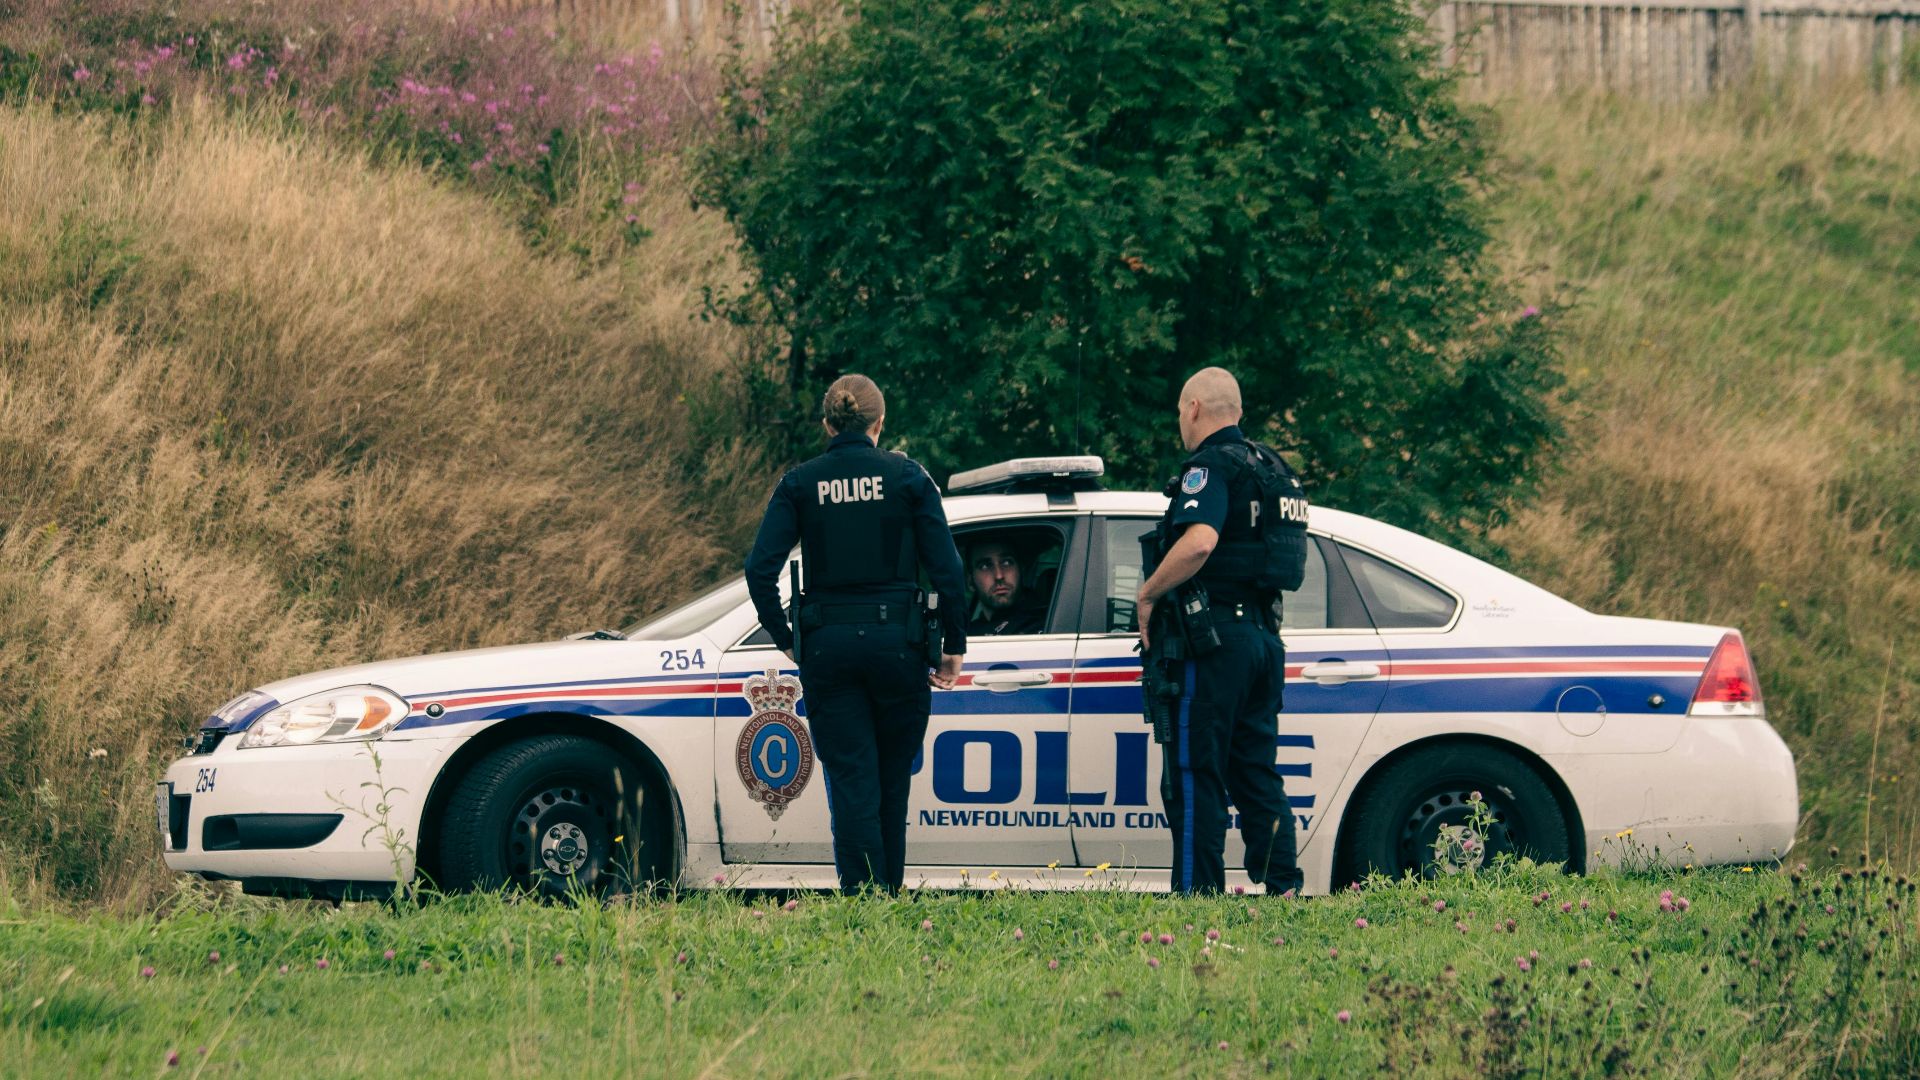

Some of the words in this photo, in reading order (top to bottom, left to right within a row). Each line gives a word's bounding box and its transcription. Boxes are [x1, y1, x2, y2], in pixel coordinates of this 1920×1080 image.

[817, 476, 884, 505] POLICE
[660, 648, 705, 671] 254
[740, 713, 799, 750] NEWFOUNDLAND
[740, 751, 753, 780] ROYAL
[758, 734, 787, 779] C
[790, 730, 811, 795] CONSTABULARY
[196, 768, 217, 792] 254
[920, 810, 1115, 828] NEWFOUNDLAND
